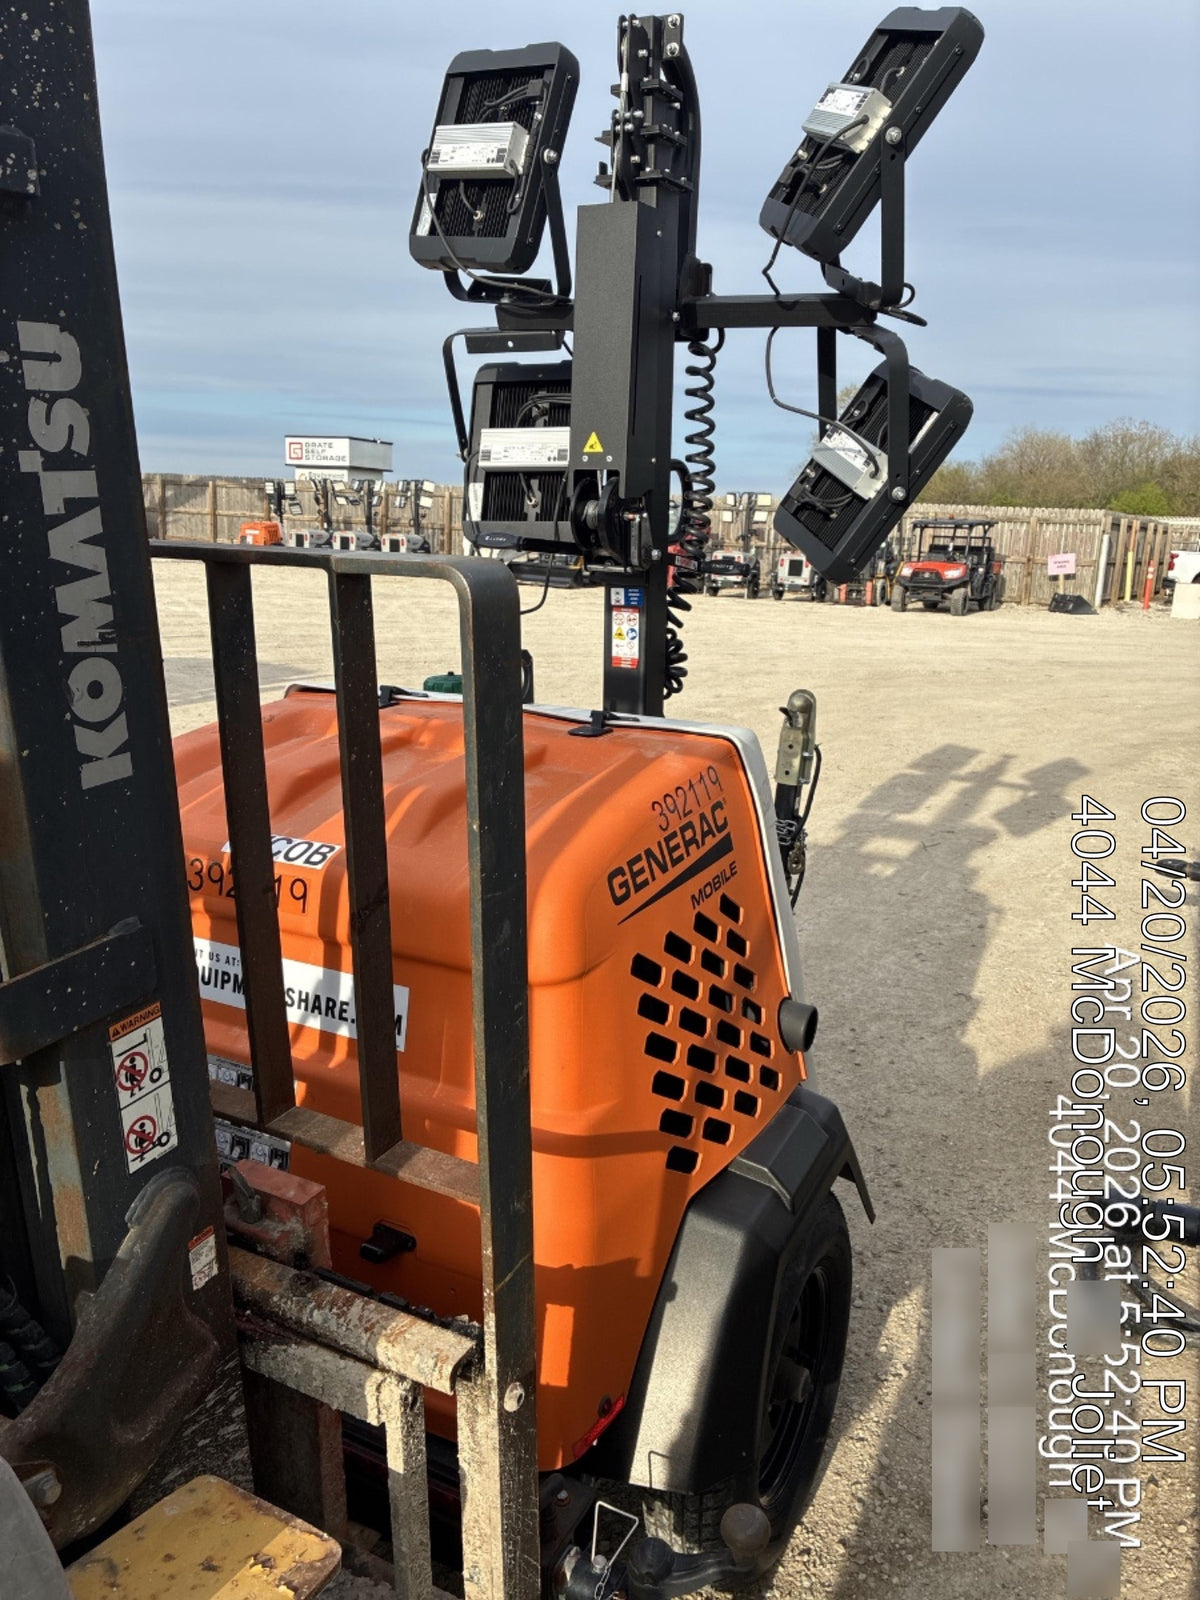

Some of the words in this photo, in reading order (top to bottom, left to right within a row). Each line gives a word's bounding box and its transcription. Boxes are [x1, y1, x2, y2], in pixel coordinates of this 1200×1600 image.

[16, 320, 133, 790] KOMATSU
[650, 765, 723, 832] 392119
[607, 800, 729, 906] GENERAC
[690, 860, 738, 910] MOBILE
[209, 951, 221, 963] US
[225, 955, 240, 967] AT:
[120, 1004, 160, 1032] WARNING
